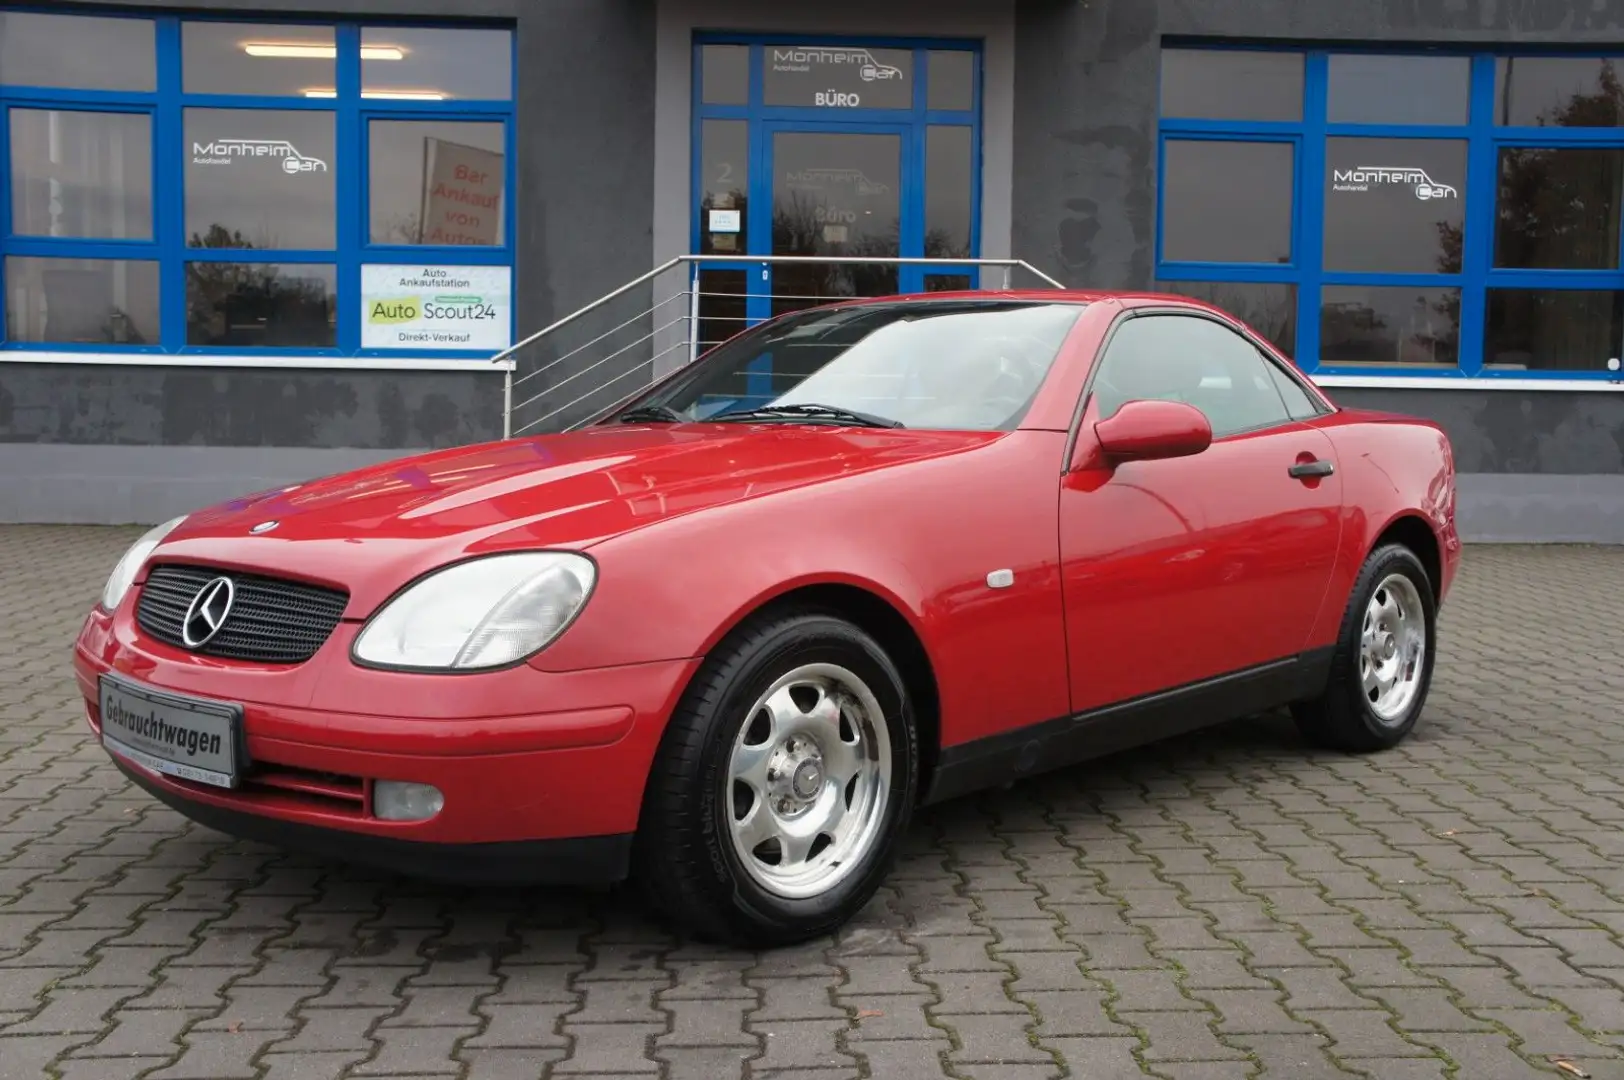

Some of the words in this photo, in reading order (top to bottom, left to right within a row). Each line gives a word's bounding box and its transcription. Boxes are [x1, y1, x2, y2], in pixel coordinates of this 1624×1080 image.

[773, 49, 869, 64] Monheim
[815, 88, 860, 106] BÜRO
[193, 141, 291, 156] Monheim
[1333, 169, 1425, 184] Monheim
[446, 210, 480, 228] von
[422, 269, 447, 278] Auto
[399, 278, 470, 288] Ankaufstation
[372, 302, 416, 318] Auto
[423, 302, 496, 320] Scout24
[398, 332, 471, 342] Direkt-Verkauf
[106, 694, 221, 757] Gebrauchtwagen
